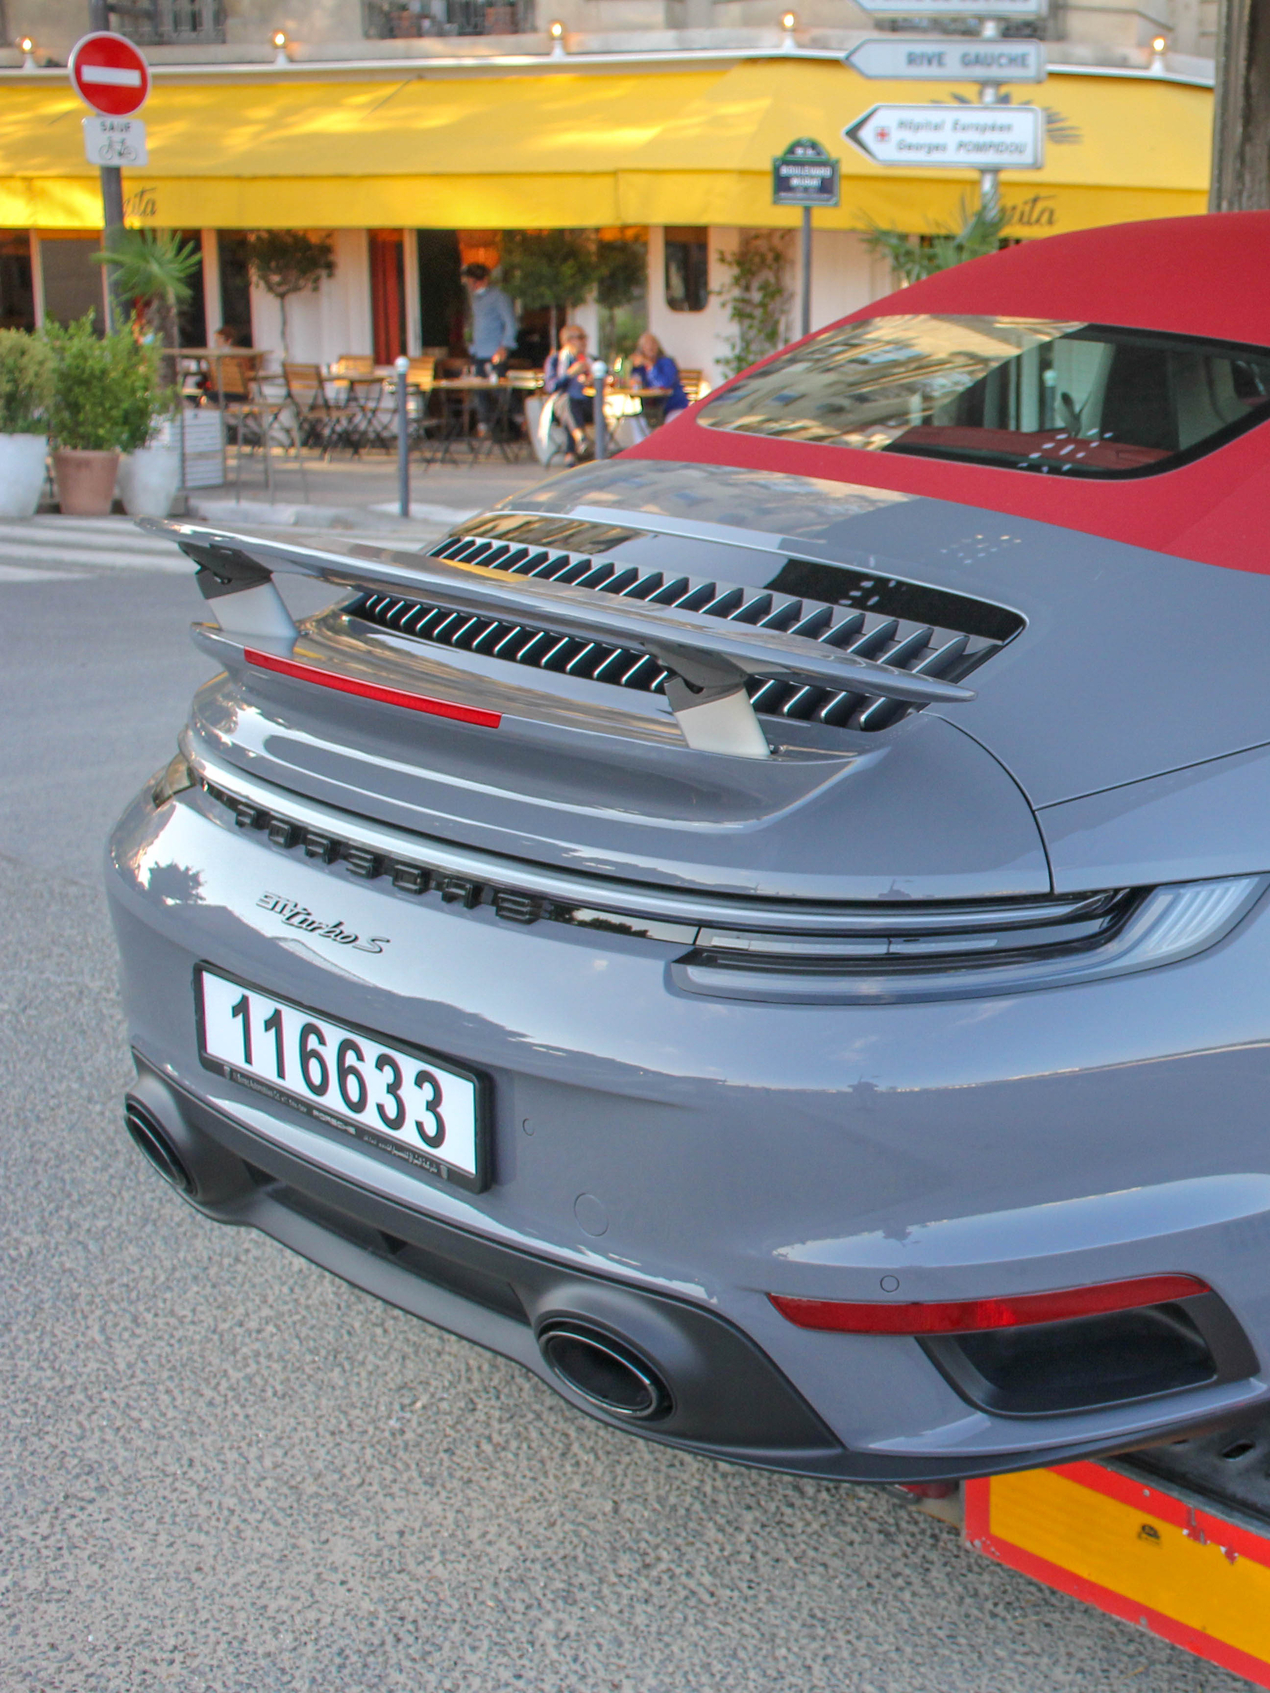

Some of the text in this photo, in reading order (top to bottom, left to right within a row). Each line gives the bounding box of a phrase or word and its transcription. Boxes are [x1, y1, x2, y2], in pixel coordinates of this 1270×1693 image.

[906, 52, 1030, 68] RIVE GAUCHE
[100, 120, 131, 132] SAUF
[896, 139, 1027, 155] Georges POMPIDOU
[780, 164, 832, 178] BOULEVARD
[235, 803, 540, 925] PORSCHE
[281, 908, 359, 945] Turbo
[352, 935, 391, 954] S
[231, 993, 447, 1150] 116633
